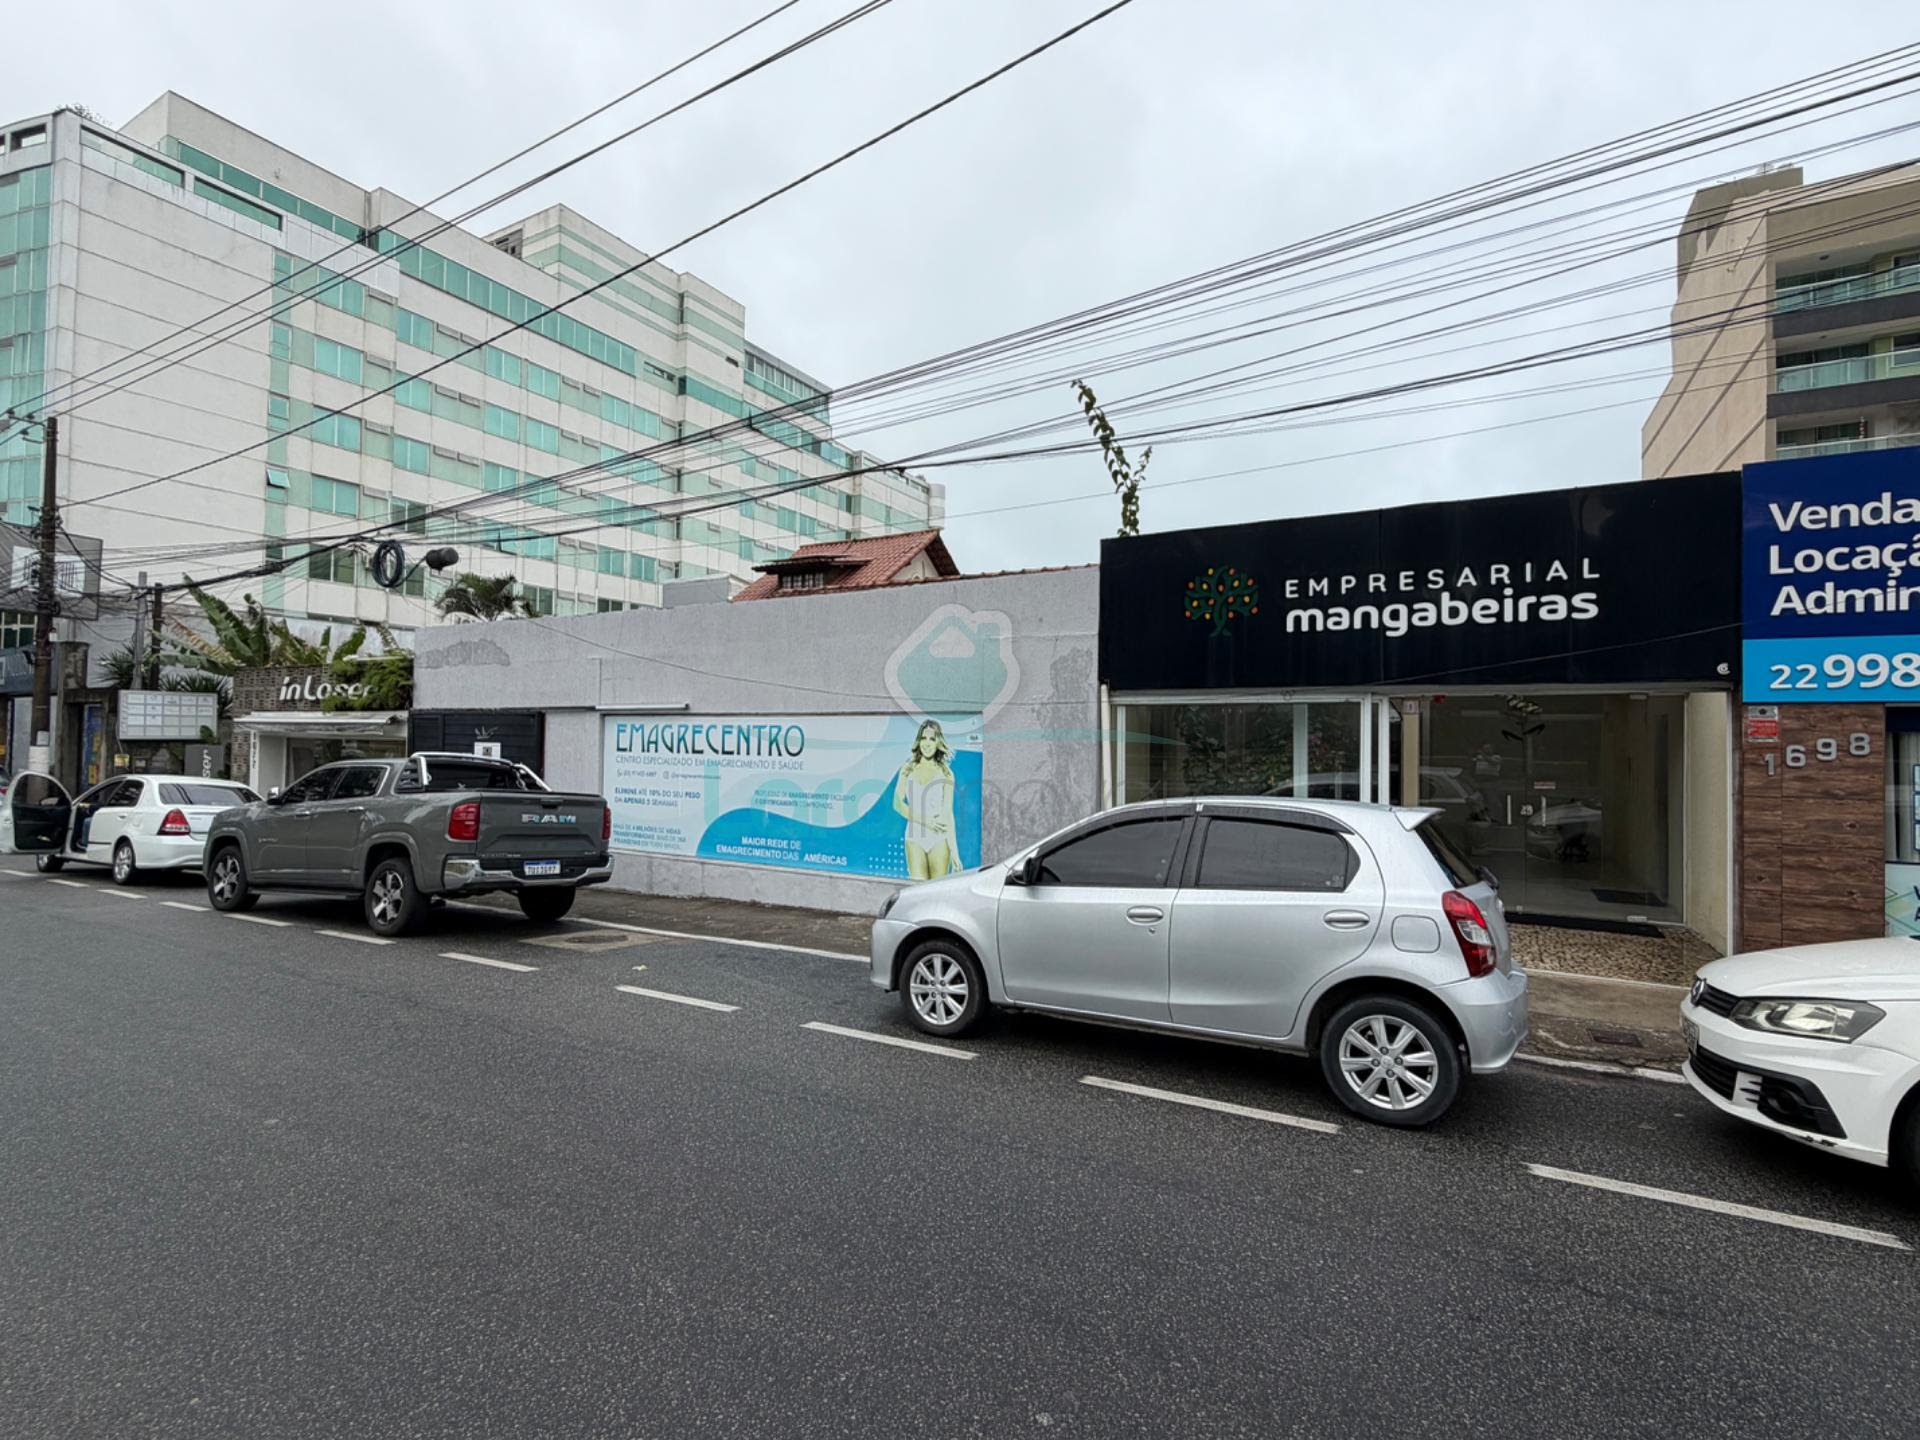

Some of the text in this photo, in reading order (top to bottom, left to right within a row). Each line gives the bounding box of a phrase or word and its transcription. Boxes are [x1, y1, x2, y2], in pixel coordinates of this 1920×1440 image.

[1768, 491, 1920, 532] Venda
[1285, 557, 1600, 599] EMPRESARIAL
[1286, 587, 1599, 637] mangabeiras
[1770, 579, 1920, 616] Admin
[1769, 652, 1920, 689] 22 998
[616, 724, 805, 757] EMAGRECENTRO
[1765, 732, 1871, 776] 1698
[616, 755, 641, 764] CENTRO
[643, 756, 693, 766] ESPECIALIZADO
[707, 758, 769, 769] EMAGRECIMENTO
[778, 759, 804, 770] SAÚDE
[624, 797, 645, 805] APENAS
[685, 791, 701, 799] PESO
[522, 813, 577, 824] RAM
[716, 844, 848, 866] EMAGRECIMENTO DAS AMÉRICAS
[742, 836, 801, 849] MAIOR REDE DE
